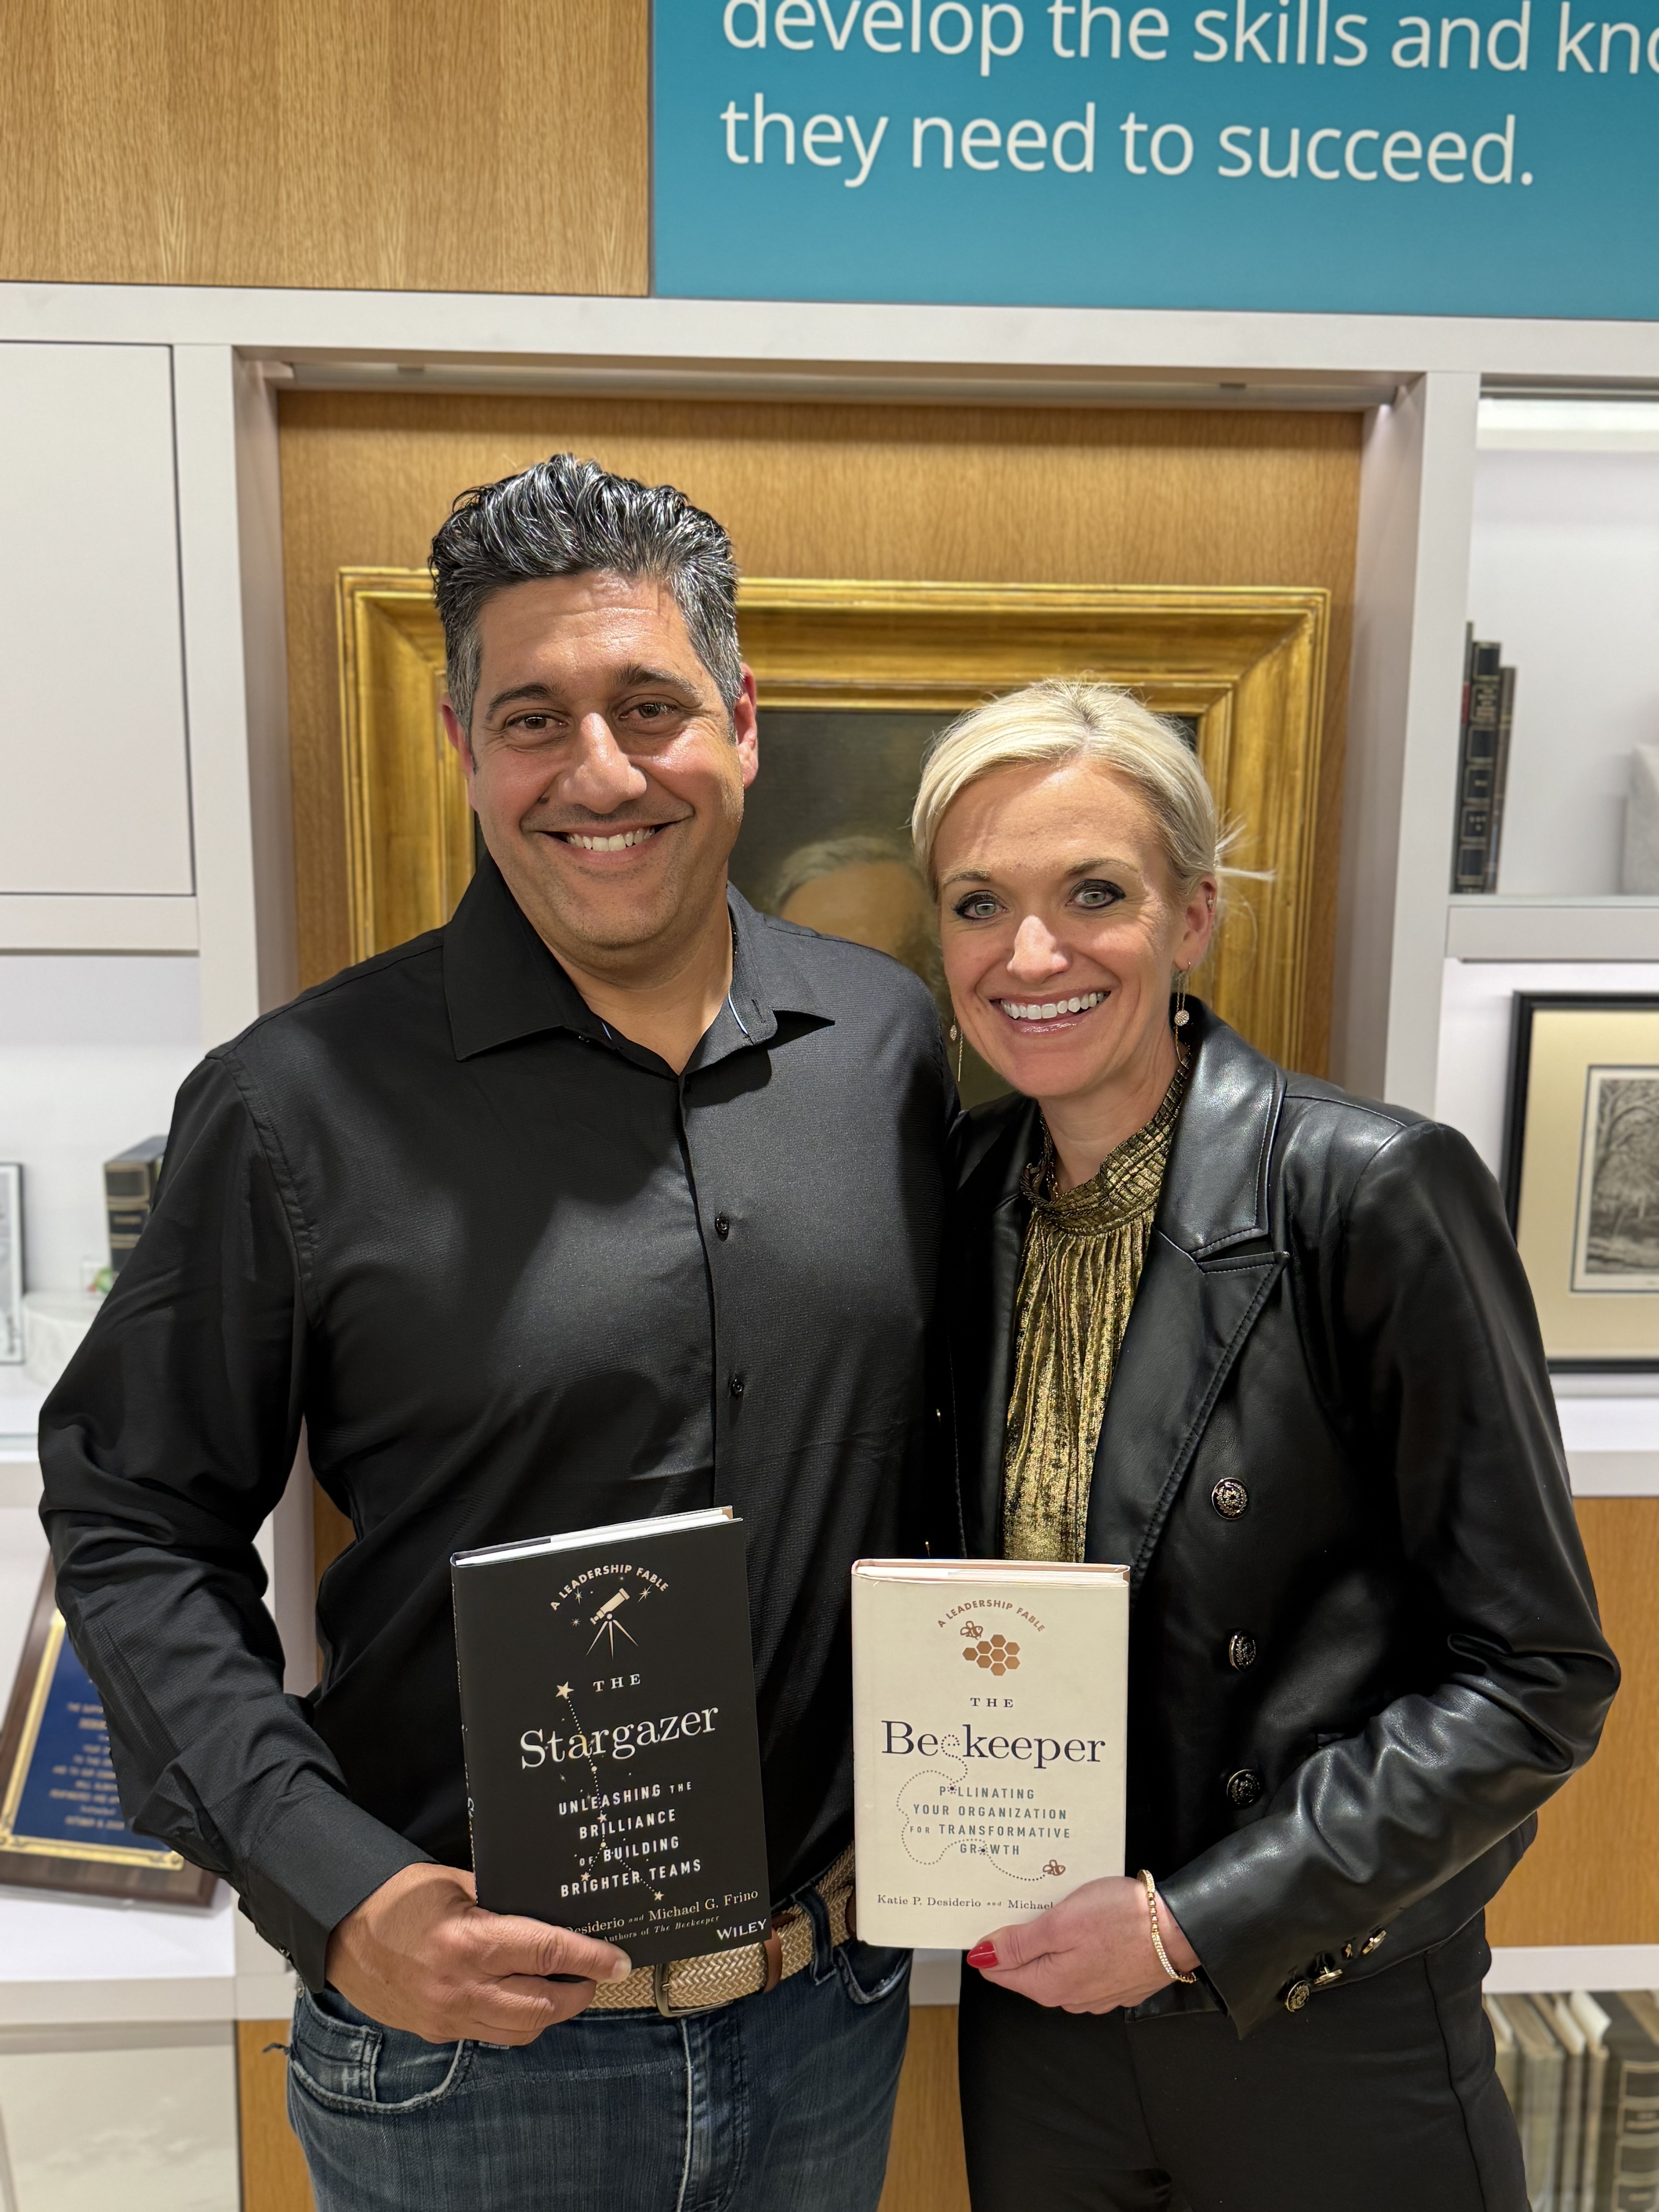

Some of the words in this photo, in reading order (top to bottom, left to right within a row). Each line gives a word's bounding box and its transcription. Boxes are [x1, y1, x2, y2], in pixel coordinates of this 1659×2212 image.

[723, 0, 1024, 77] develop
[1047, 0, 1170, 60] the
[1194, 0, 1368, 66] skills
[1391, 0, 1531, 71] and
[720, 93, 889, 188] they
[913, 102, 1096, 173] need
[1120, 112, 1193, 175] to
[1218, 115, 1533, 186] succeed.
[550, 1602, 560, 1611] A
[559, 1564, 632, 1599] LEADERSHIP
[636, 1567, 669, 1592] FABLE
[938, 1620, 946, 1628] A
[946, 1599, 1013, 1620] LEADERSHIP
[1016, 1607, 1045, 1632] FABLE
[593, 1674, 641, 1692] THE
[970, 1698, 1013, 1708] THE
[520, 1707, 719, 1770] Stargazer
[881, 1720, 1106, 1769] Beekeeper
[558, 1784, 661, 1815] UNLEASHING
[670, 1781, 692, 1794] THE
[914, 1803, 949, 1815] YOUR
[958, 1806, 1066, 1819] ORGANIZATION
[579, 1809, 675, 1839] BRILLIANCE
[939, 1824, 1070, 1838] TRANSFORMATIVE
[579, 1856, 594, 1867] OF
[603, 1836, 679, 1862] BUILDING
[561, 1871, 640, 1898] BRIGHTER
[649, 1859, 701, 1880] TEAMS
[629, 1914, 644, 1923] and
[649, 1902, 700, 1921] Michael
[705, 1898, 719, 1910] G.
[724, 1891, 758, 1906] Frino
[878, 1894, 908, 1905] Katie
[912, 1896, 922, 1905] P.
[927, 1897, 981, 1907] Desiderio
[1008, 1899, 1053, 1910] Michael
[641, 1927, 649, 1936] of
[654, 1925, 670, 1934] The
[675, 1916, 720, 1930] Beekeeper
[716, 1918, 767, 1940] WILEY
